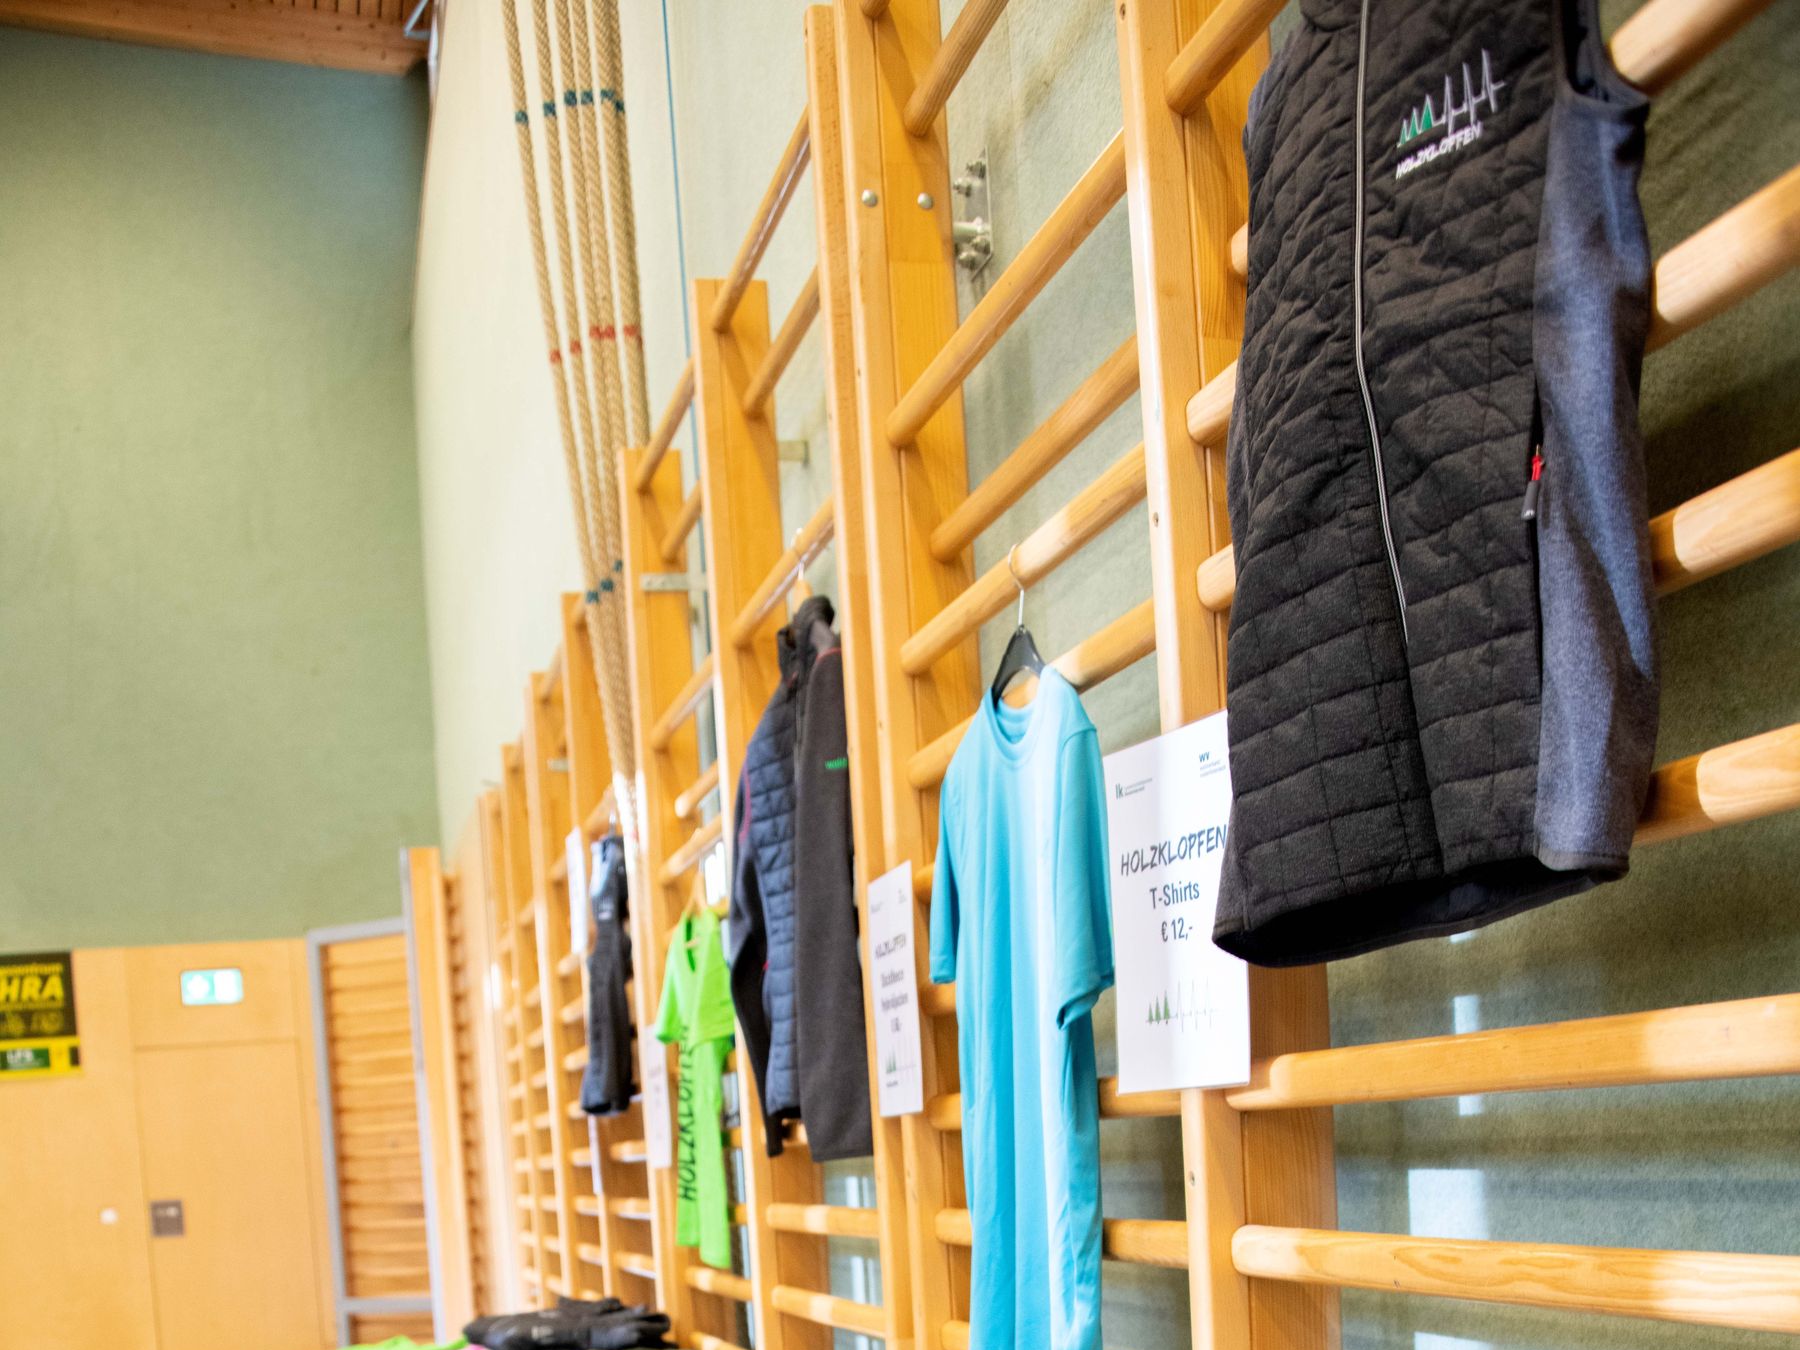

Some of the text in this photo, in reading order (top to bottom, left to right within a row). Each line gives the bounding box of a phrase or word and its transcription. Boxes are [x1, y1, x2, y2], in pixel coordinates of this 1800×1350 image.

[1120, 824, 1227, 877] HOLZKLOPFEN
[1149, 881, 1200, 910] T-Shirts
[1161, 917, 1193, 942] € 12,-
